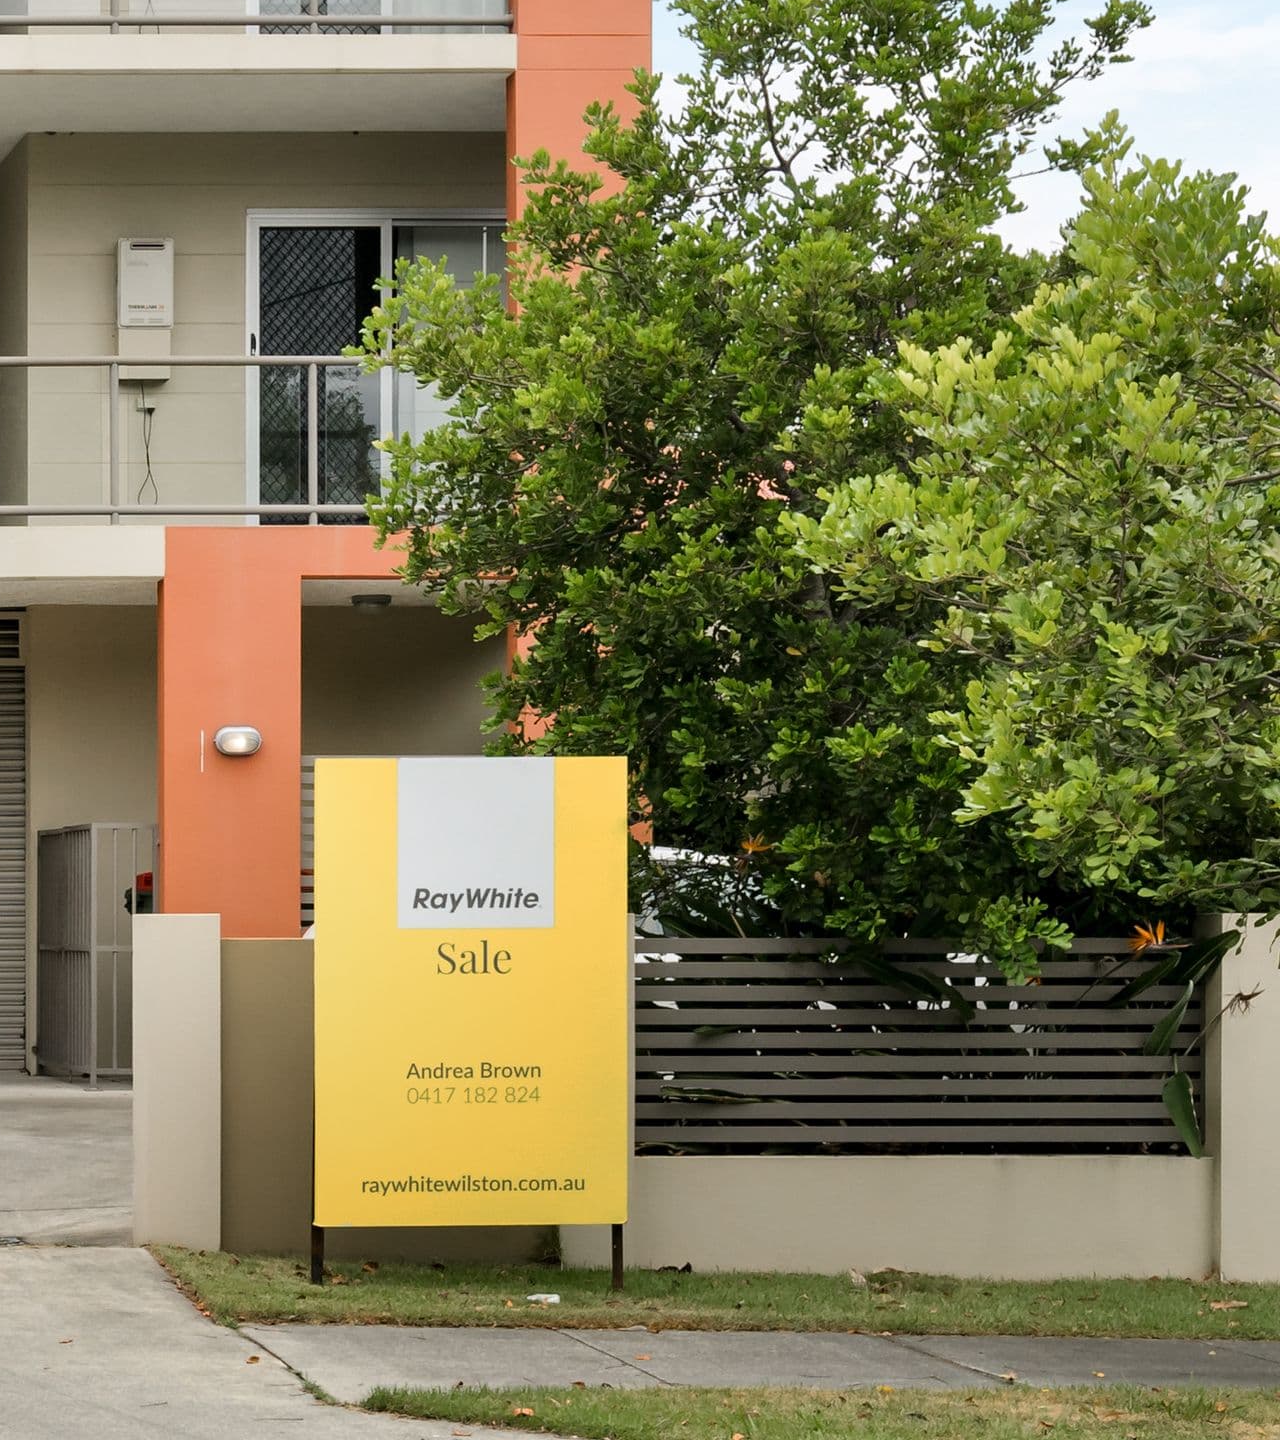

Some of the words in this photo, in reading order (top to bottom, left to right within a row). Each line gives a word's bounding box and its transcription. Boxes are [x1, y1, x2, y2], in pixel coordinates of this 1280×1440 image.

[437, 939, 513, 975] Sale
[406, 1062, 474, 1080] Andrea
[480, 1061, 542, 1079] Brown
[406, 1086, 456, 1105] 0417
[463, 1086, 498, 1105] 182
[504, 1085, 542, 1104] 824
[361, 1174, 586, 1197] raywhitewilston.com.au
